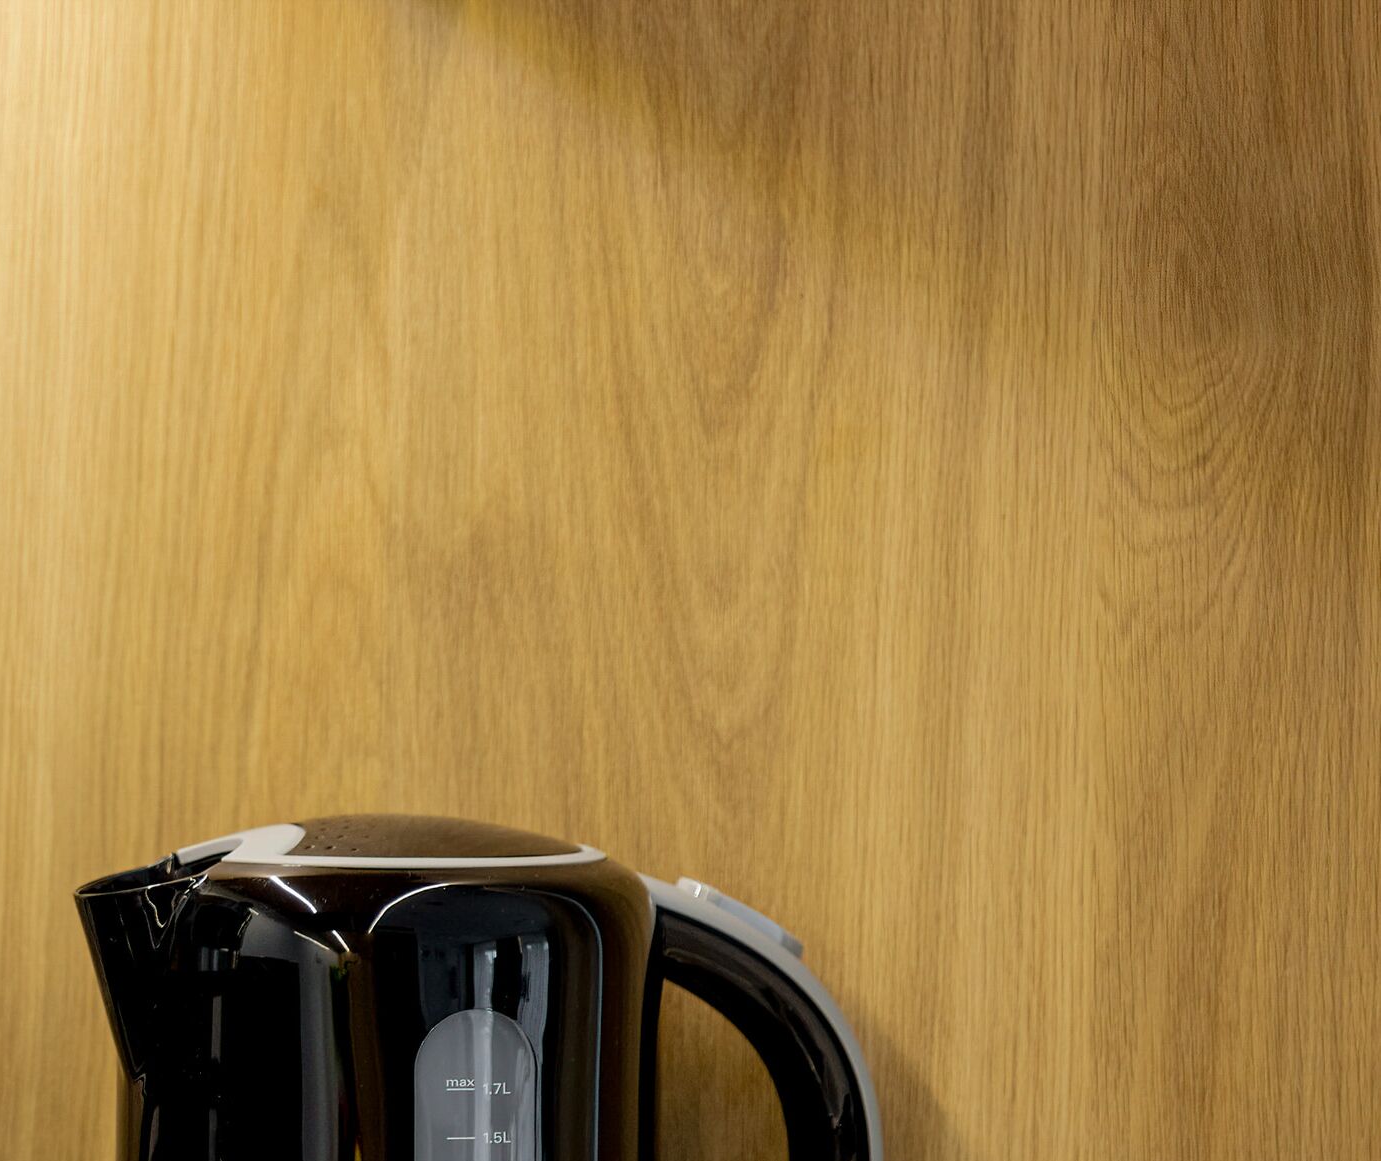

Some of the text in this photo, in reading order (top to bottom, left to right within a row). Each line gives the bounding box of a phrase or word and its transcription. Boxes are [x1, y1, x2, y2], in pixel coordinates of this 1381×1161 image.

[446, 1078, 511, 1095] max 1.7L
[482, 1131, 512, 1144] 1.5L
